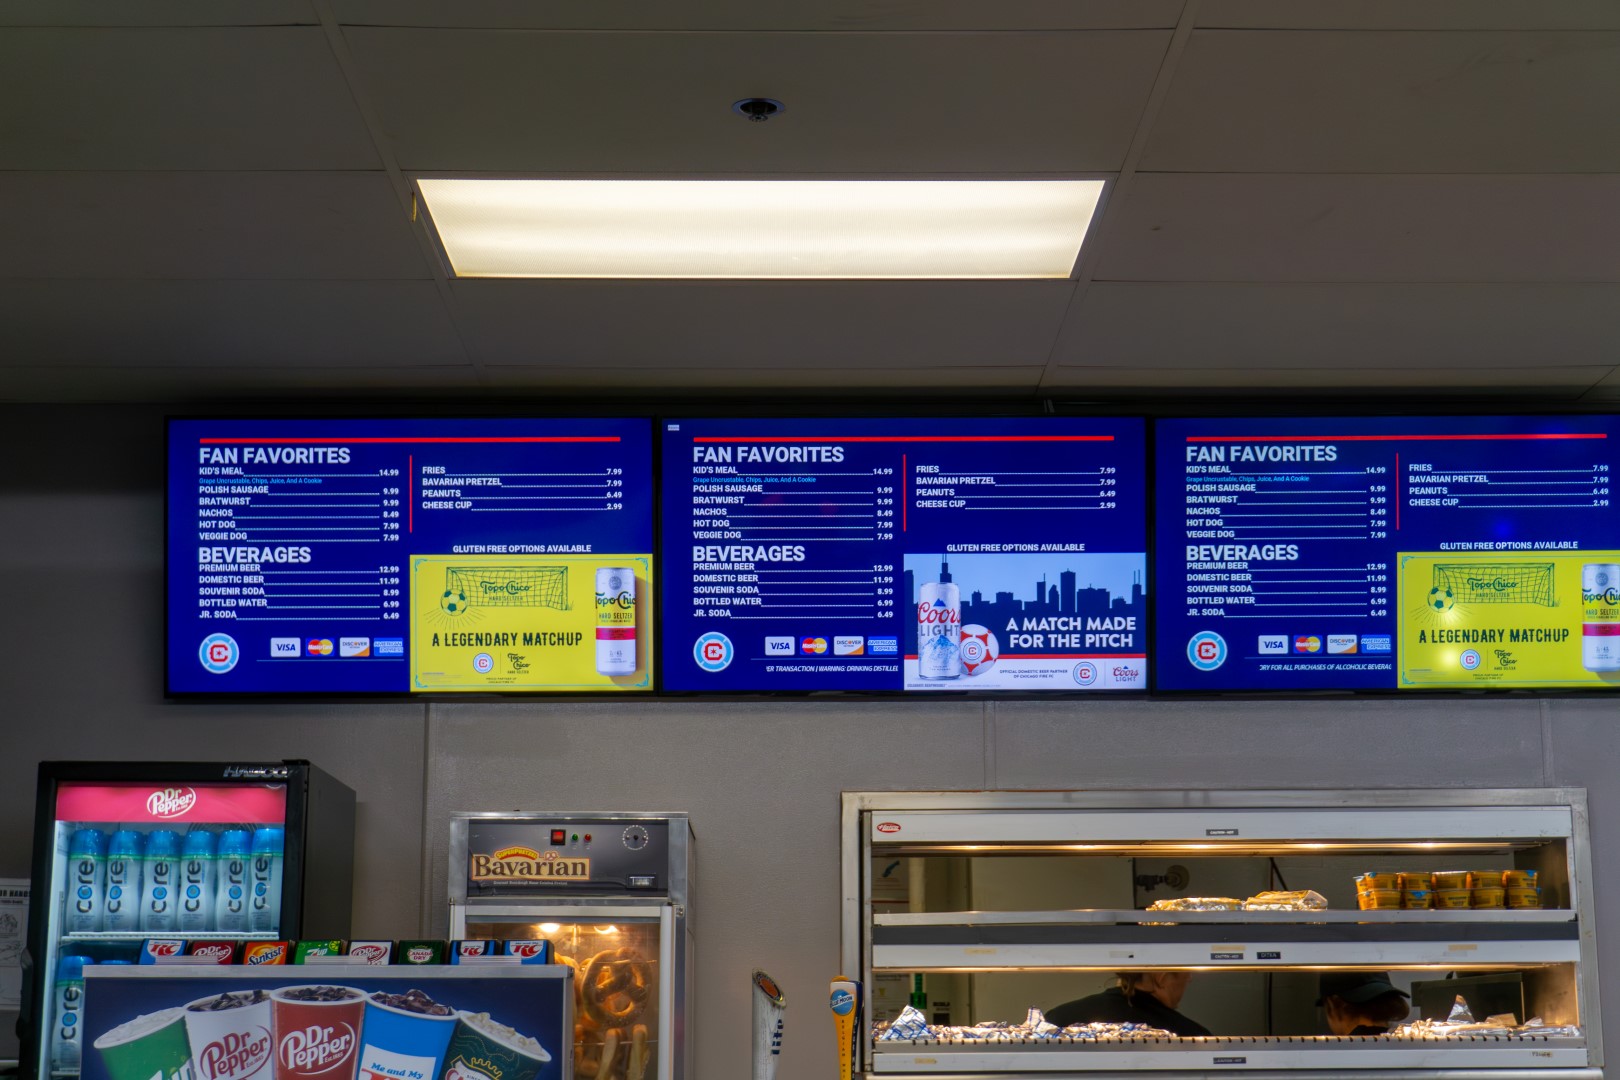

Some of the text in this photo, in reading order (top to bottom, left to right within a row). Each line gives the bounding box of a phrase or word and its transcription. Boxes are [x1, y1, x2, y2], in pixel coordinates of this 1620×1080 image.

[200, 448, 350, 464] FAN FAVORITES
[694, 447, 844, 462] FAN FAVORITES
[1186, 446, 1337, 462] FAN FAVORITES
[199, 547, 311, 563] BEVERAGES
[693, 546, 805, 561] BEVERAGES
[1186, 545, 1298, 561] BEVERAGES
[480, 580, 532, 595] Topo Chico
[1467, 577, 1518, 591] Topo Chico
[918, 602, 961, 624] Coors
[920, 625, 959, 636] LIGHT
[1006, 617, 1136, 630] A MATCH MADE
[432, 633, 582, 646] A LEGENDARY MATCHUP
[1010, 634, 1133, 648] FOR THE PITCH
[1419, 629, 1569, 643] A LEGENDARY MATCHUP
[1113, 667, 1138, 677] Coors
[164, 788, 182, 800] Dr
[147, 791, 192, 815] Pepper
[474, 856, 587, 876] Bavarian
[76, 860, 94, 913] core
[108, 860, 123, 913] core
[152, 860, 168, 913] core
[185, 860, 201, 912] core
[228, 860, 243, 913] core
[254, 858, 268, 910] core
[248, 946, 283, 965] Sunkist
[61, 987, 80, 1040] core
[223, 1032, 250, 1053] Dr
[306, 1025, 334, 1048] Dr
[200, 1038, 268, 1078] Pepper
[280, 1031, 350, 1070] Pepper
[371, 1063, 423, 1079] Me and My
